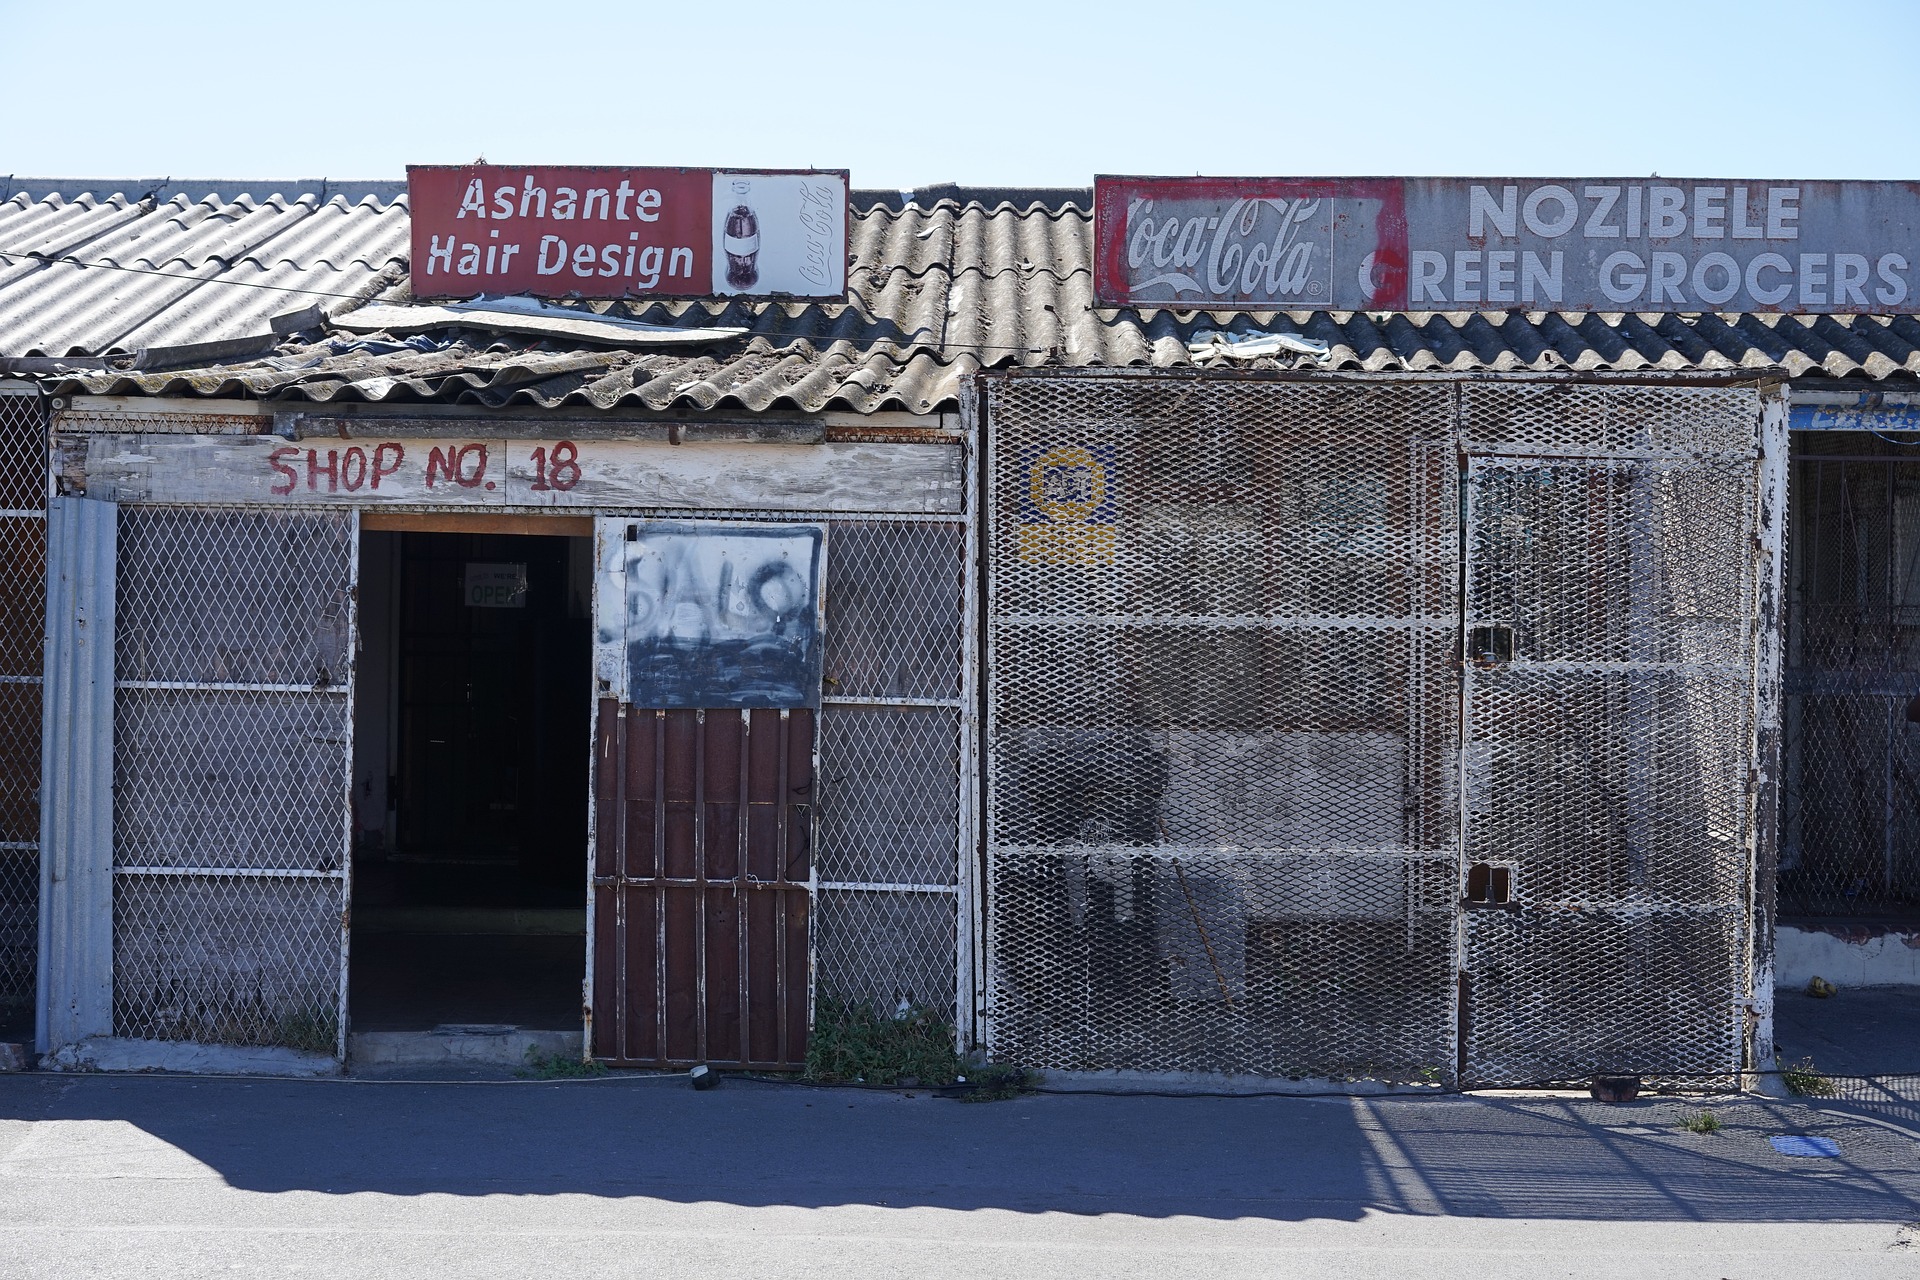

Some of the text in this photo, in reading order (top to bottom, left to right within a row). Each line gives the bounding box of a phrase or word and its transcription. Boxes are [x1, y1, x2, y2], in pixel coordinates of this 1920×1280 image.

[456, 174, 662, 222] Ashante
[1468, 184, 1800, 240] NOZIBELE
[426, 229, 693, 289] Hair Design
[1599, 251, 1909, 306] GROCERS
[268, 440, 582, 496] SHOP NO. 18
[471, 585, 517, 605] OPEN
